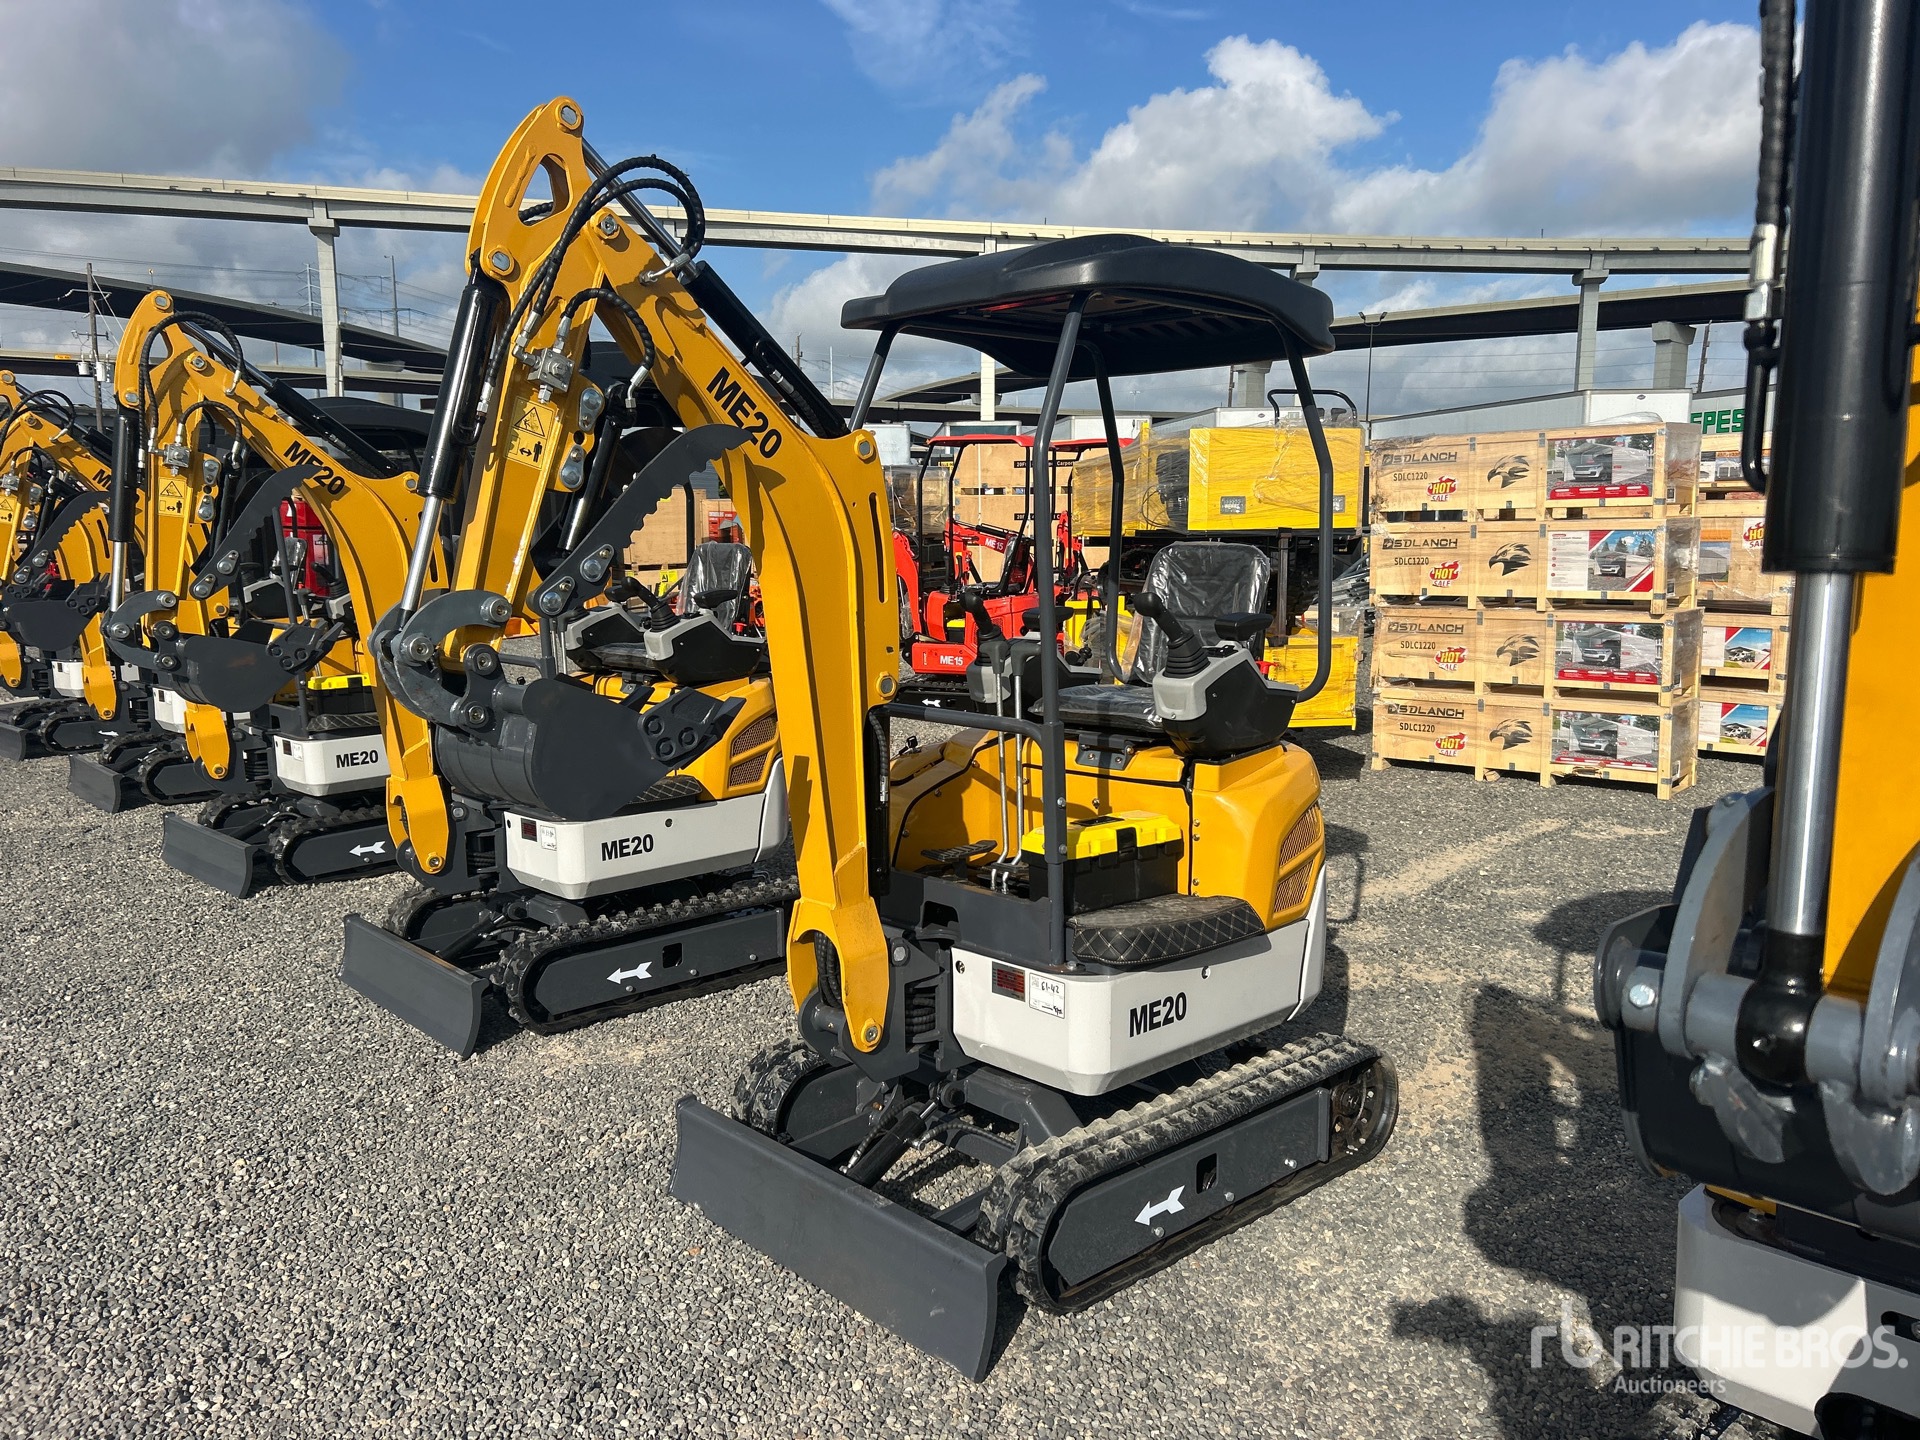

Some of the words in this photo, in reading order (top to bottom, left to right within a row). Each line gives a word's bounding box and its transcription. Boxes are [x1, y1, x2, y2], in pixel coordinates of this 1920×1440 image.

[706, 366, 782, 458] ME20
[1393, 452, 1457, 463] SDLANCH
[1393, 472, 1428, 481] SDLC1220
[1432, 482, 1452, 494] HOT
[1749, 528, 1764, 540] HO
[1394, 539, 1457, 548] SDLANCH
[1394, 557, 1429, 565] SDLC1220
[1434, 568, 1454, 579] HOT
[1399, 623, 1464, 632] SDLANCH
[1400, 641, 1436, 650] SDLC1220
[940, 655, 963, 666] ME15
[1441, 651, 1460, 663] HOT
[1399, 705, 1465, 717] SDLANCH
[1399, 722, 1435, 733] SDLC1220
[1441, 738, 1460, 749] HOT
[336, 750, 378, 768] ME20
[601, 834, 654, 861] ME20
[1129, 991, 1187, 1038] ME20
